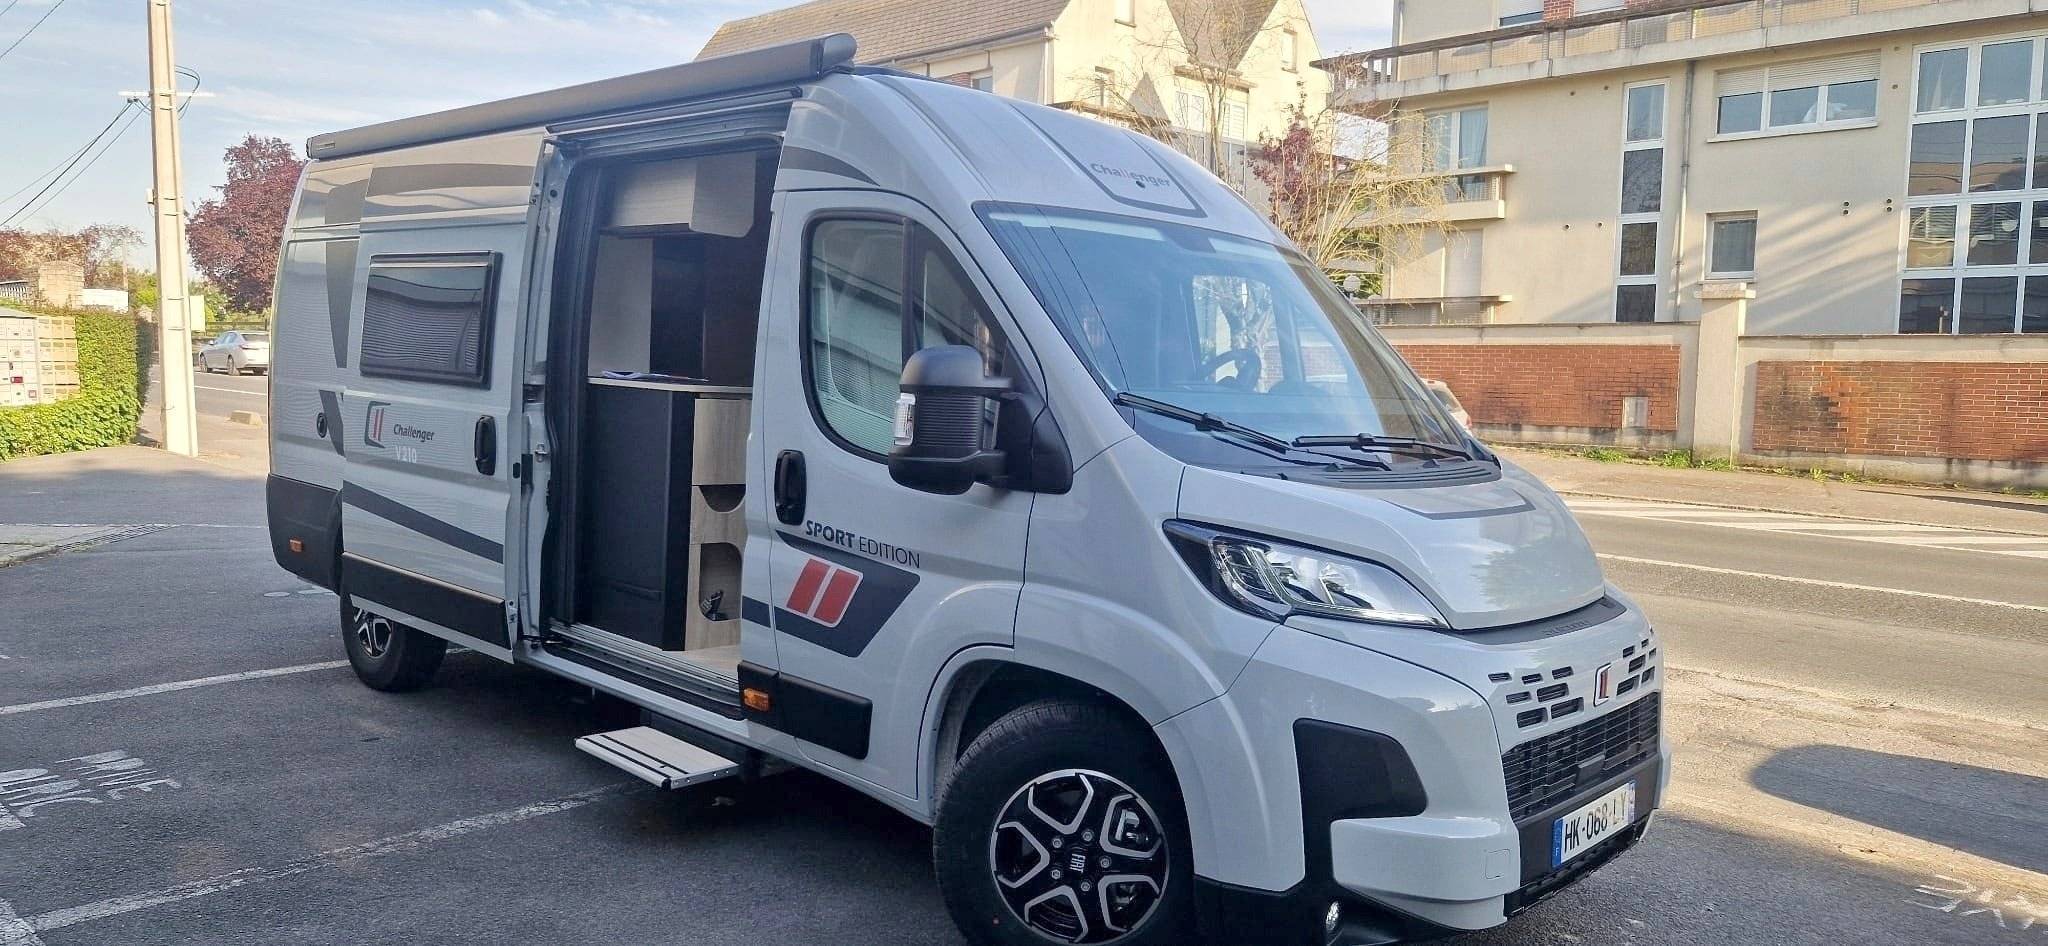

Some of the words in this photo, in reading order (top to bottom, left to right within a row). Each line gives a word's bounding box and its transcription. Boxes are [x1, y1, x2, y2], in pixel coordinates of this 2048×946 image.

[1090, 162, 1170, 187] Challenger
[393, 423, 435, 443] Challenger
[806, 520, 855, 549] SPORT
[859, 536, 920, 569] EDITION
[1564, 791, 1627, 854] HK-068-LY
[1069, 853, 1086, 873] FIAT
